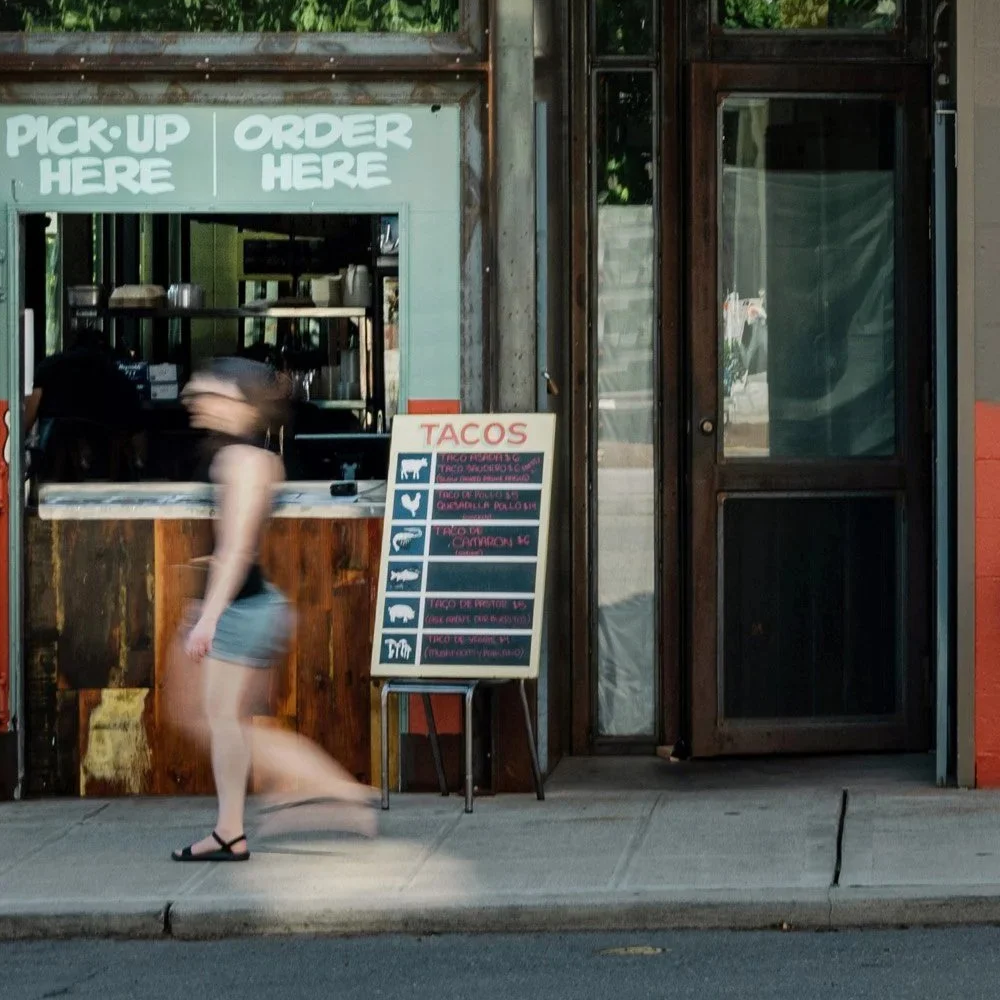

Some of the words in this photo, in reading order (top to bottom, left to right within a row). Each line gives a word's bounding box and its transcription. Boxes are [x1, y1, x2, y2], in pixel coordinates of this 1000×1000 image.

[234, 113, 412, 150] ORDER
[39, 157, 175, 195] HERE
[262, 152, 392, 191] HERE
[420, 422, 528, 445] TACOS
